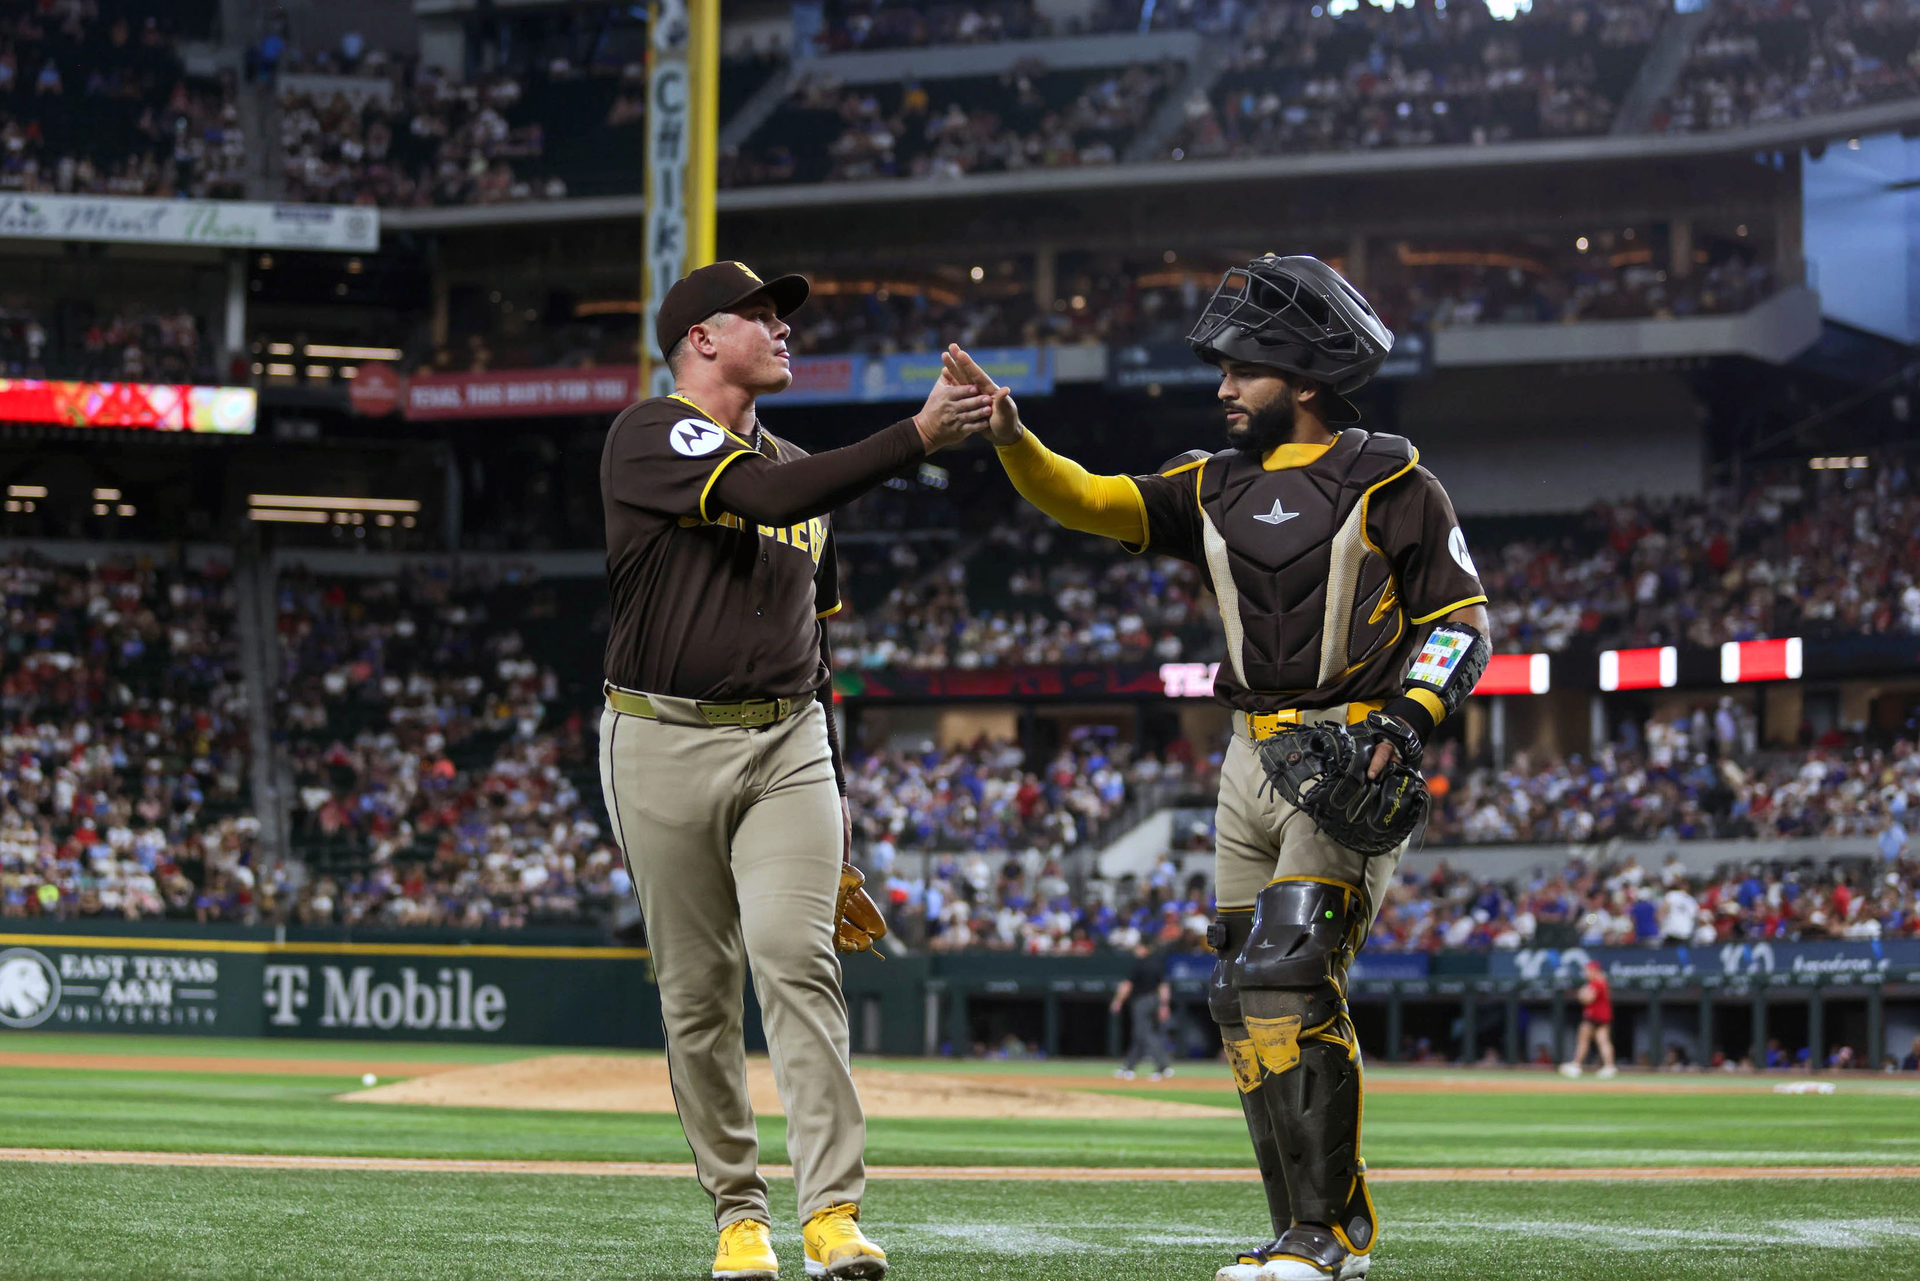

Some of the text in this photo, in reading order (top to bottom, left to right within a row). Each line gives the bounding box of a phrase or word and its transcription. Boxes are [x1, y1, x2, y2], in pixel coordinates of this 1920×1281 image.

[60, 953, 218, 984] EAST TEXAS
[102, 977, 173, 1006] A&M
[263, 964, 507, 1032] T Mobile
[57, 1002, 218, 1026] UNIVERSITY
